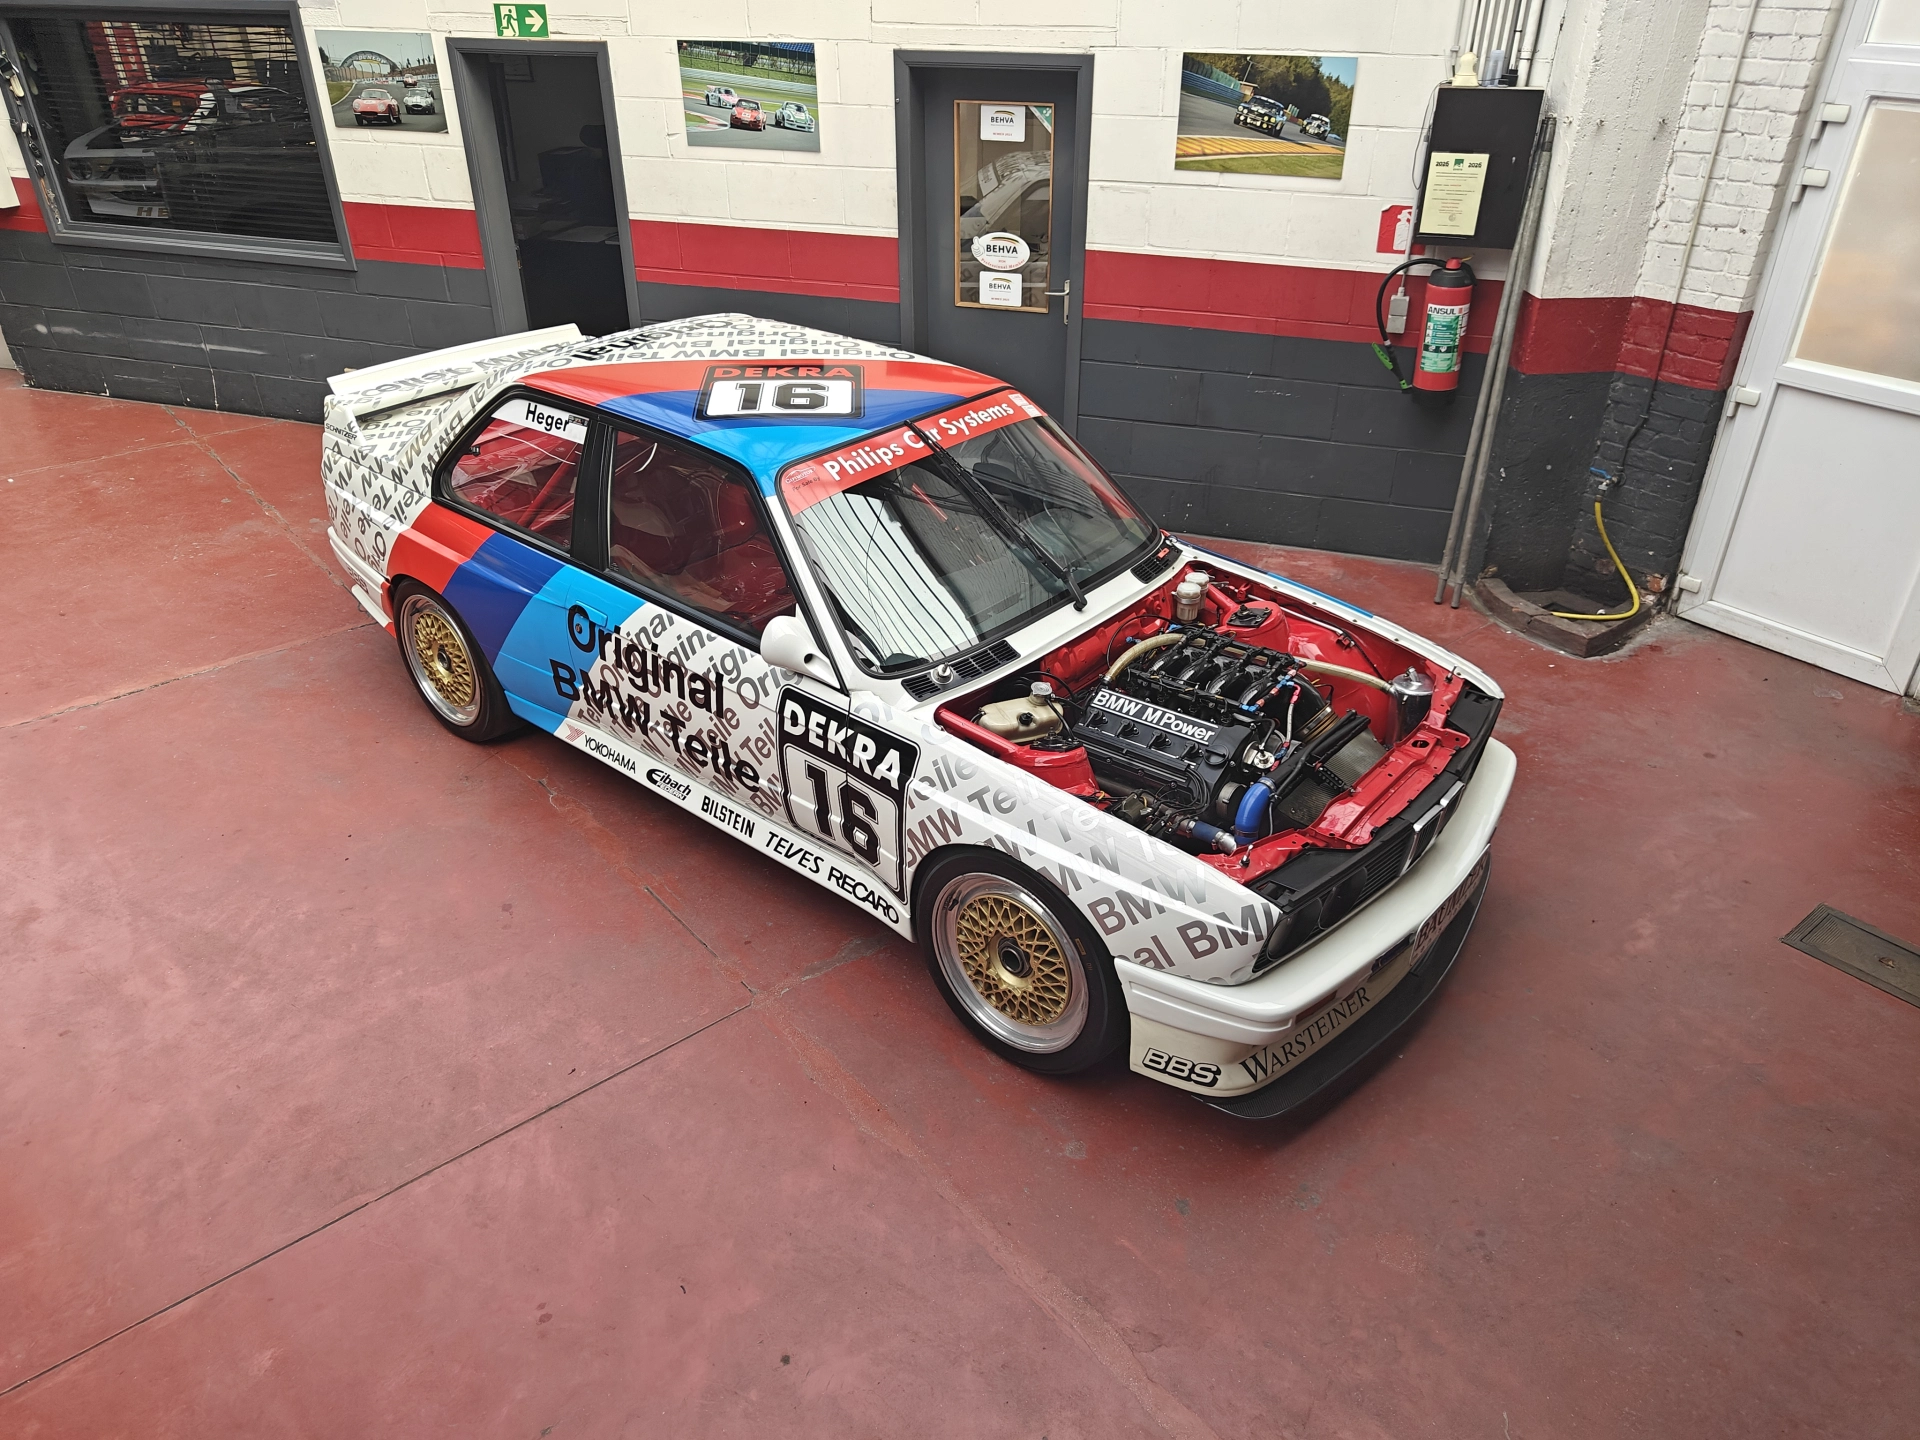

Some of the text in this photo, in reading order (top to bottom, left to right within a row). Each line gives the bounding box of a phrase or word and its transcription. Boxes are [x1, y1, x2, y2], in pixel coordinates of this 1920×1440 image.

[990, 116, 1014, 124] BEHVA
[981, 257, 1025, 269] Professional Member
[986, 244, 1018, 254] BEHVA
[1428, 306, 1457, 315] ANSUL
[672, 349, 765, 357] BMW
[727, 338, 860, 348] Original
[782, 348, 915, 360] Original
[714, 366, 855, 379] DEKRA
[735, 381, 829, 412] 16
[325, 423, 357, 440] SCHNITZER
[525, 402, 570, 432] Heger
[822, 443, 905, 481] Philips
[939, 402, 1015, 436] Systems
[567, 604, 724, 718] Original
[1092, 689, 1142, 716] BMW
[549, 658, 760, 793] BMW Teile
[584, 734, 636, 774] YOKOHAMA
[783, 699, 900, 790] DEKRA
[646, 768, 692, 796] Eibach
[700, 795, 756, 838] BILSTEIN
[804, 760, 881, 867] 16
[765, 831, 825, 874] TEVES
[827, 866, 900, 925] RECARO
[1087, 864, 1207, 937] BMW
[1119, 935, 1176, 970] al
[1239, 986, 1371, 1084] WARSTEINER
[1142, 1047, 1222, 1088] BBS
